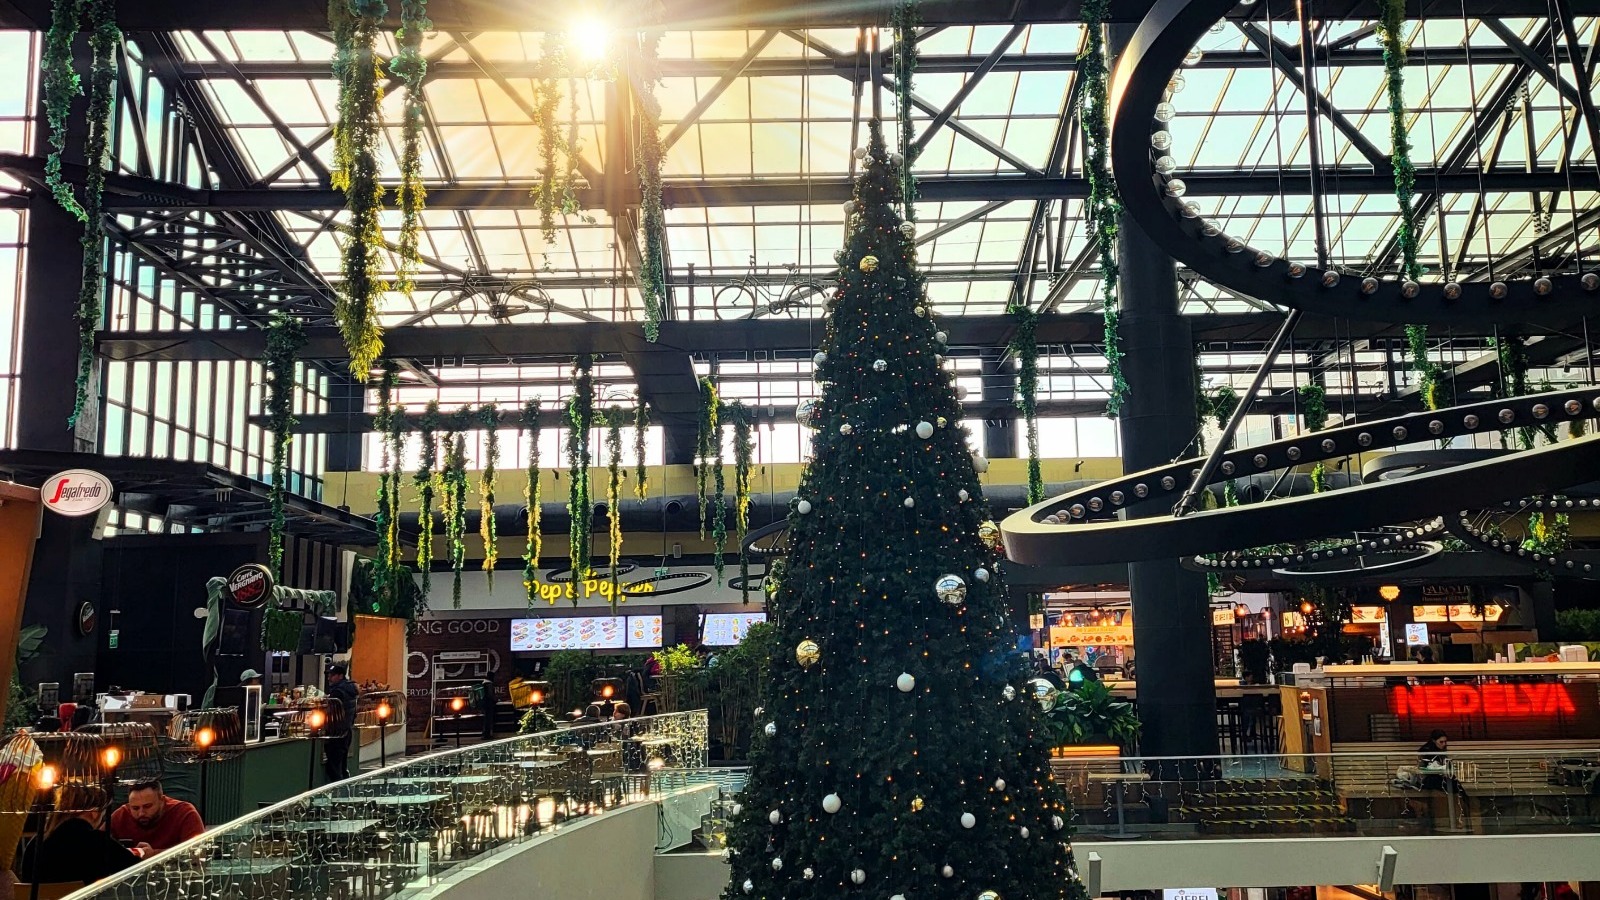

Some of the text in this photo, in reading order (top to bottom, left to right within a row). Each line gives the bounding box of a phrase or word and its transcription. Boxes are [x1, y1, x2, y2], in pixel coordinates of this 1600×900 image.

[49, 478, 101, 503] Segafredo
[448, 620, 500, 634] GOOD
[1394, 684, 1576, 714] NEDELYA
